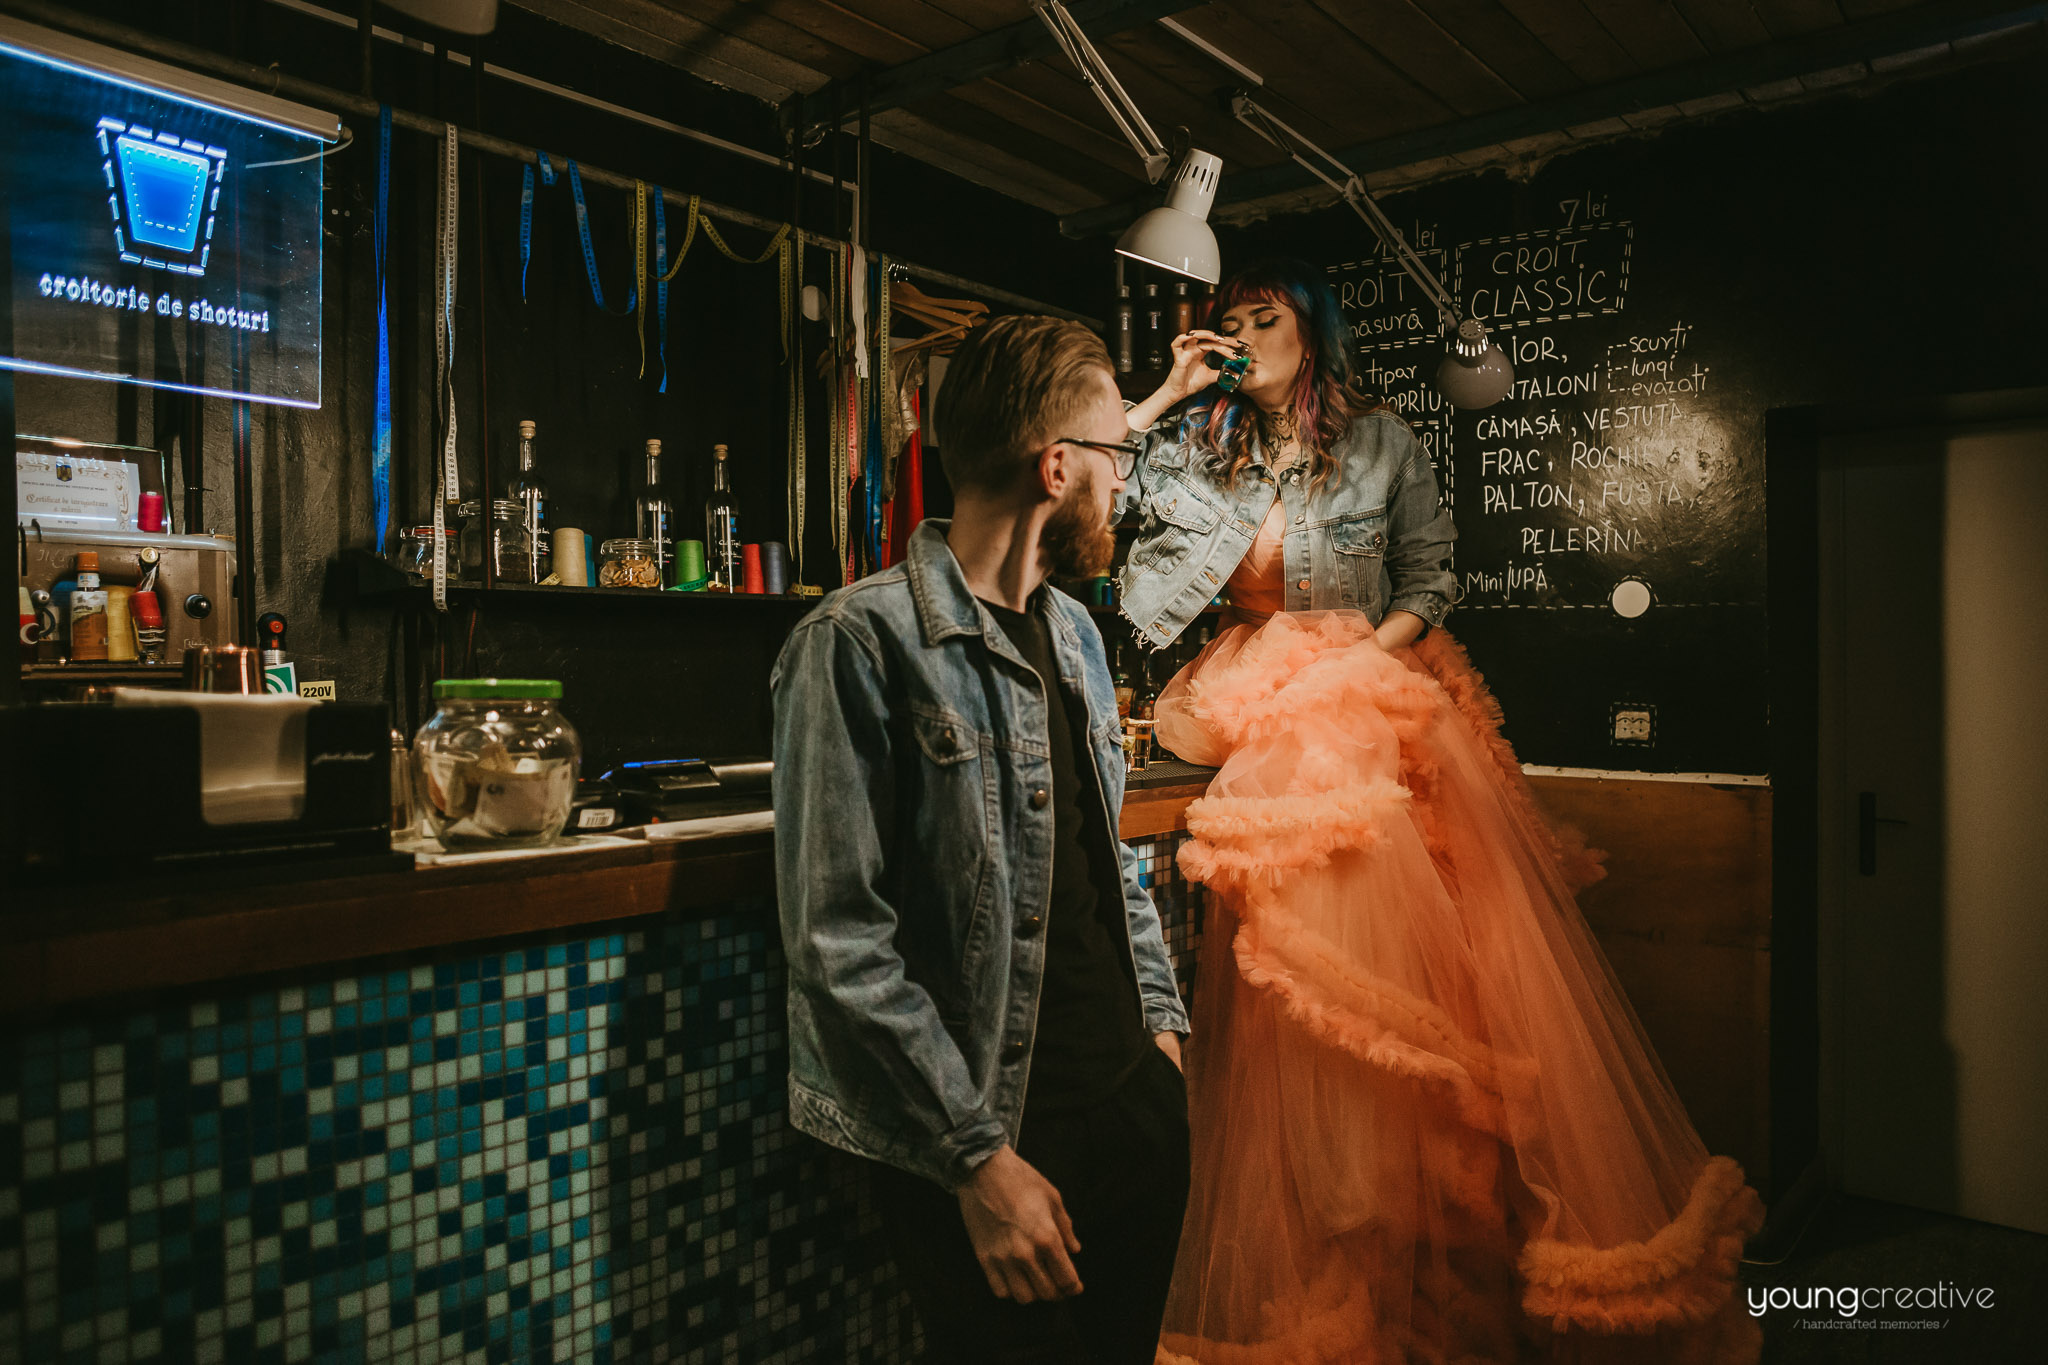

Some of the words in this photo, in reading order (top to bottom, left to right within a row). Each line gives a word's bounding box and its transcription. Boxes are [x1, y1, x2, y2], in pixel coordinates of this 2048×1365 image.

[1559, 199, 1581, 227] 7
[1587, 190, 1608, 219] lei
[1416, 218, 1439, 249] lei
[39, 273, 150, 313] croitorie
[156, 294, 183, 318] de
[189, 299, 270, 333] shoturi
[1329, 269, 1408, 310] ROIT
[1472, 263, 1607, 321] CLASSIC
[1364, 358, 1418, 394] tipar
[303, 686, 332, 698] 220V
